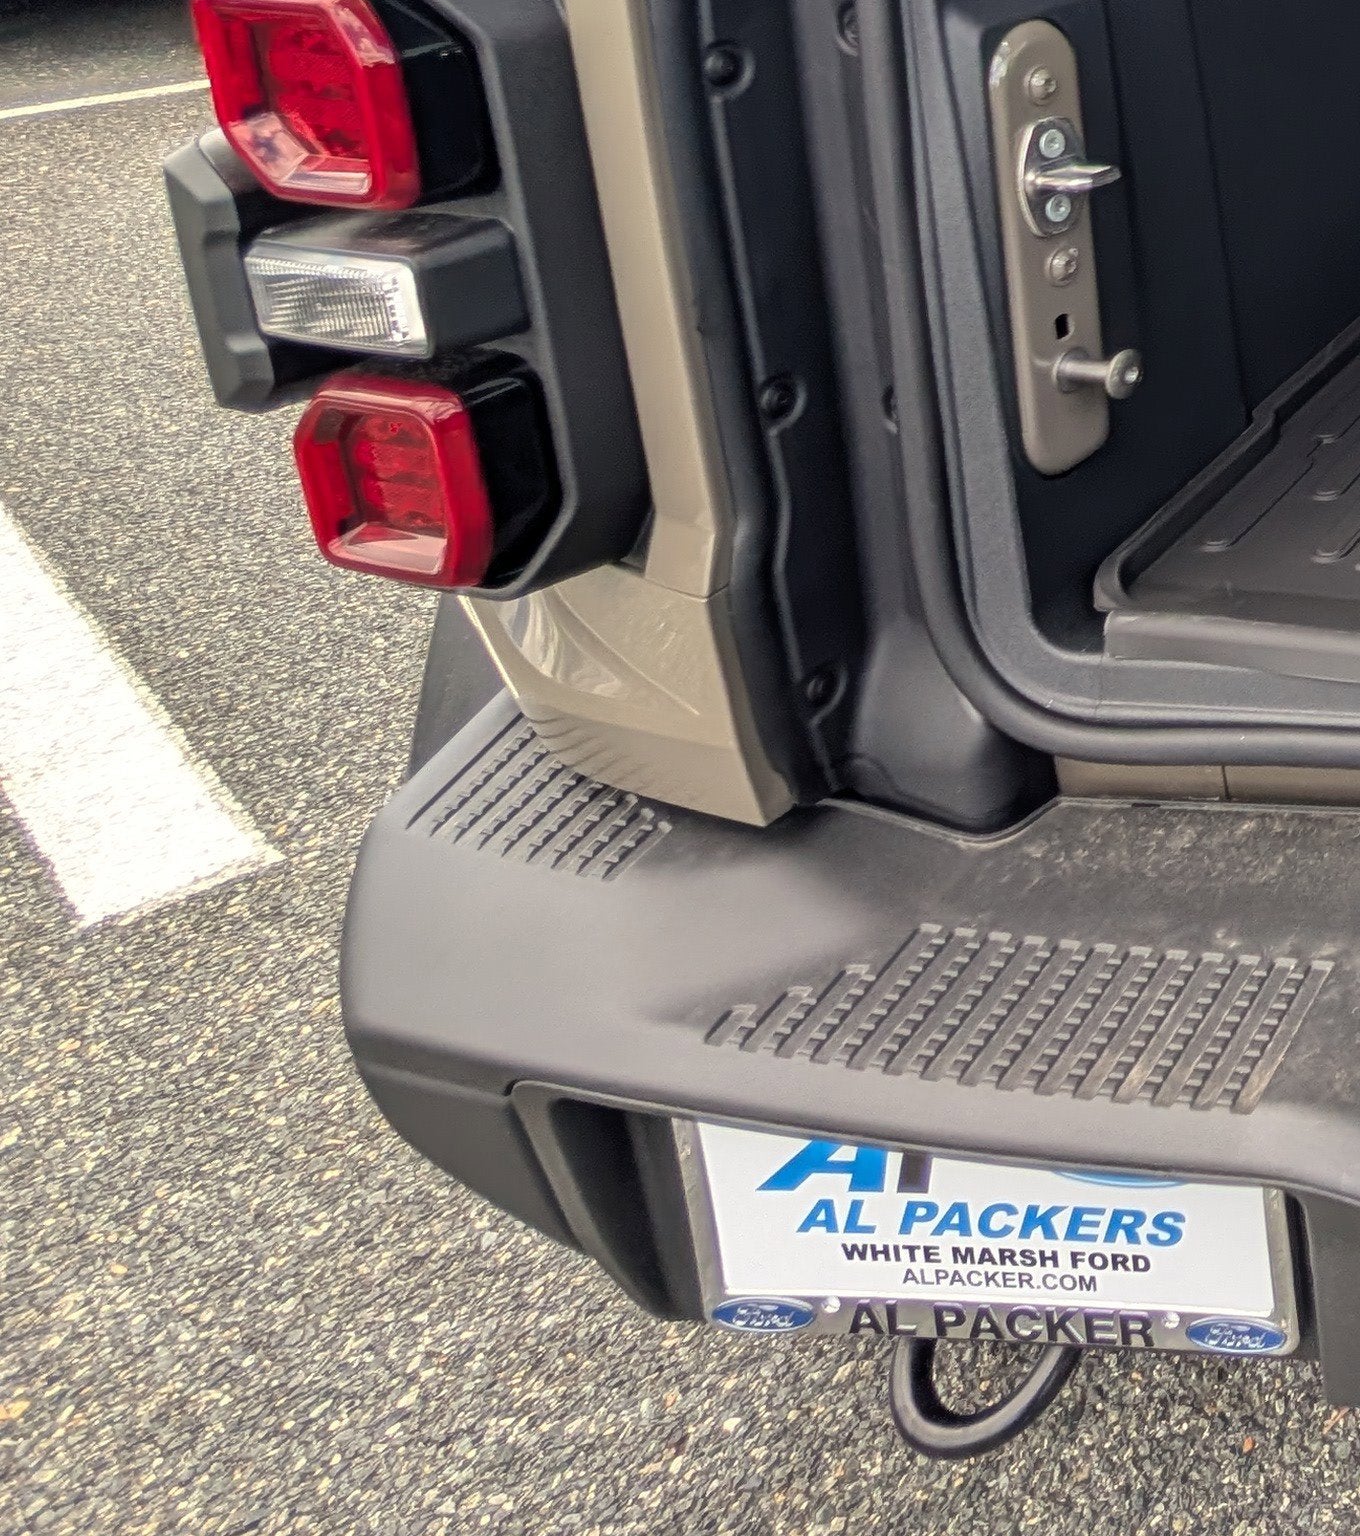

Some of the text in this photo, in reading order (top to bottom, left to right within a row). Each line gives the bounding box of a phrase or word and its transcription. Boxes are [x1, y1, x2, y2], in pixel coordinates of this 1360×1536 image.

[797, 1199, 1187, 1247] AL PACKERS
[842, 1243, 1152, 1273] WHITE MARSH FORD
[902, 1268, 1098, 1293] ALPACKER.COM
[732, 1304, 796, 1328] Ford
[850, 1299, 1155, 1347] AL PACKER
[1206, 1323, 1266, 1349] Ford
